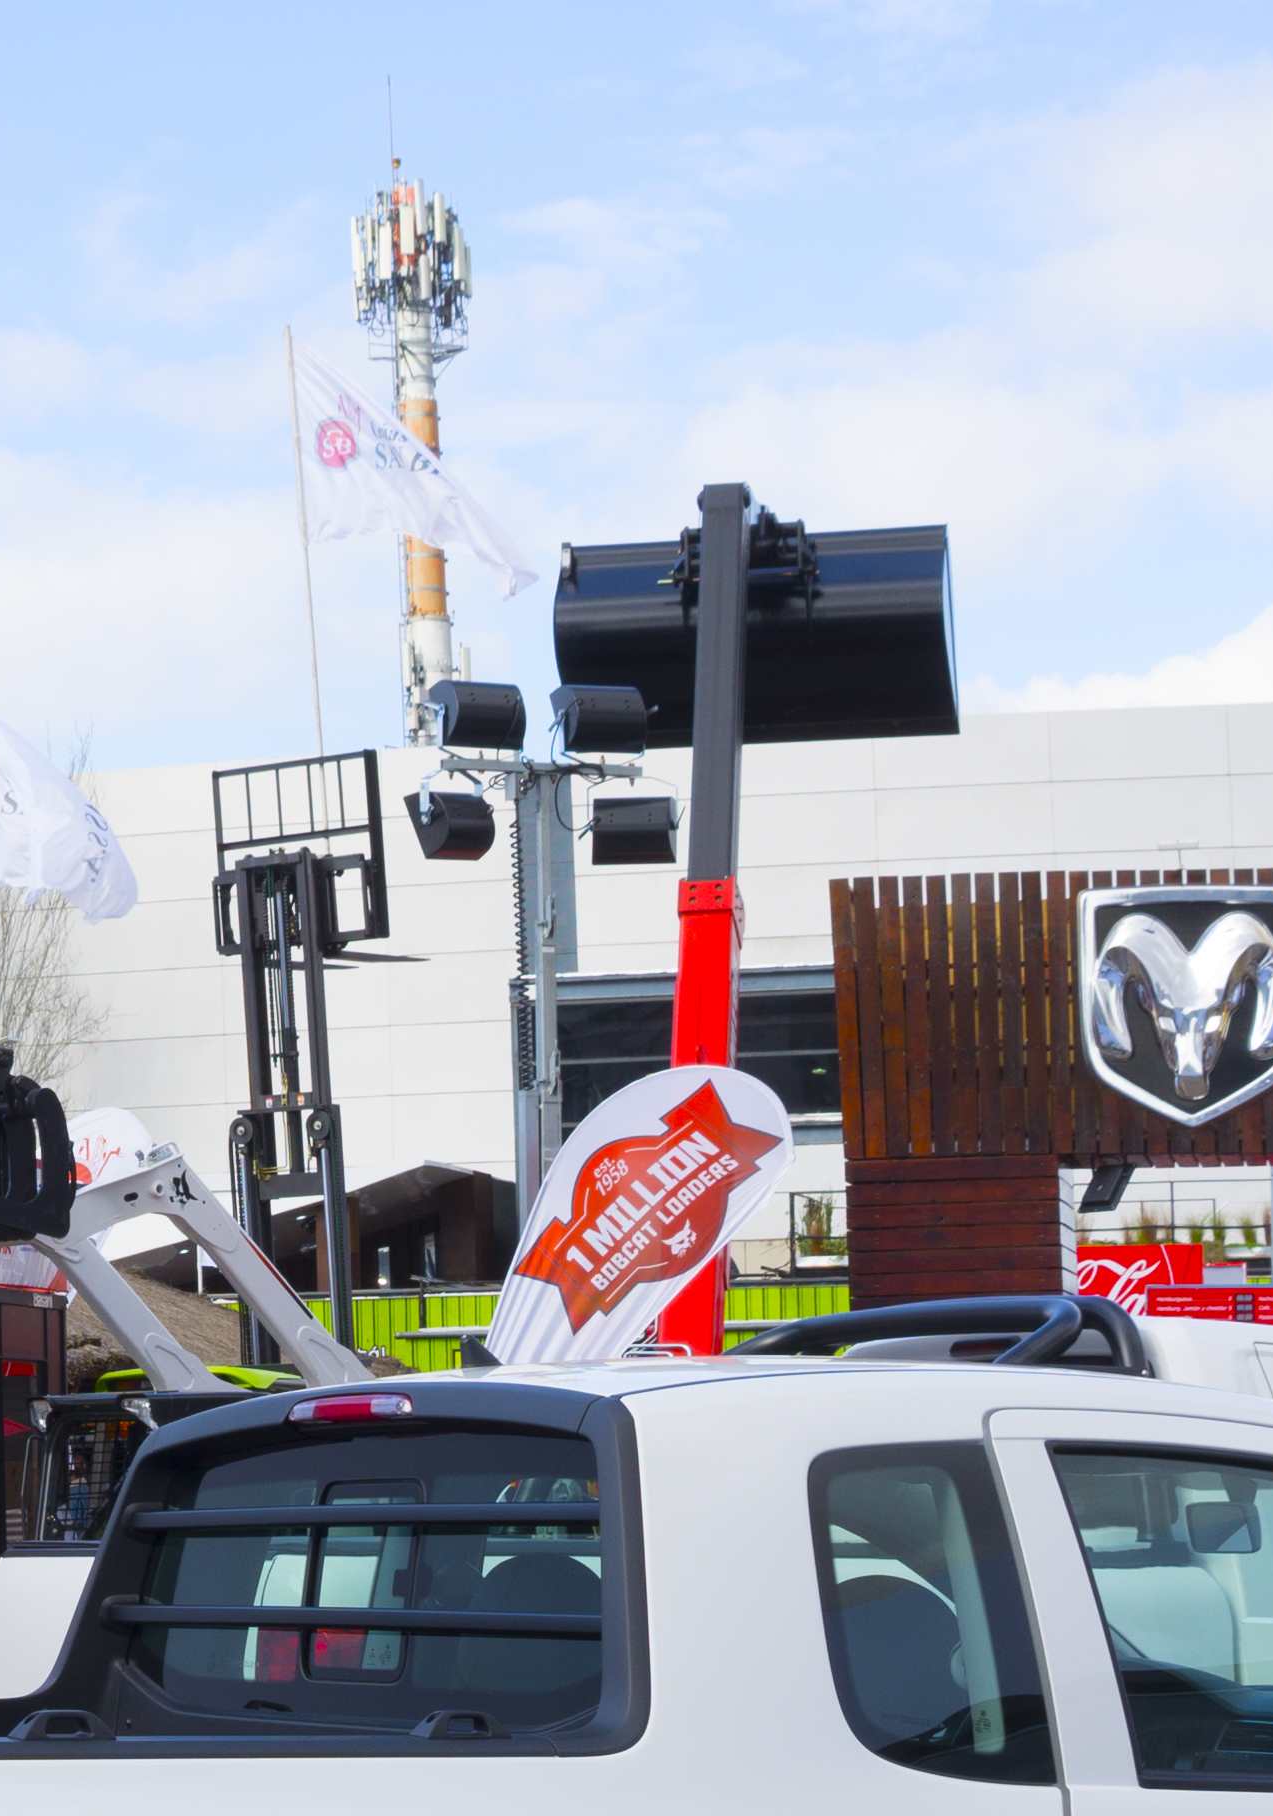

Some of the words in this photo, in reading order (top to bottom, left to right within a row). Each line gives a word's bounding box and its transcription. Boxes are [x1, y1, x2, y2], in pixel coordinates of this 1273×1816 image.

[566, 1245, 594, 1273] 1
[582, 1130, 720, 1257] MILLION
[593, 1158, 616, 1179] est.
[594, 1159, 629, 1197] 1958
[590, 1221, 658, 1291] BOBCAT
[656, 1153, 740, 1223] LOADERS
